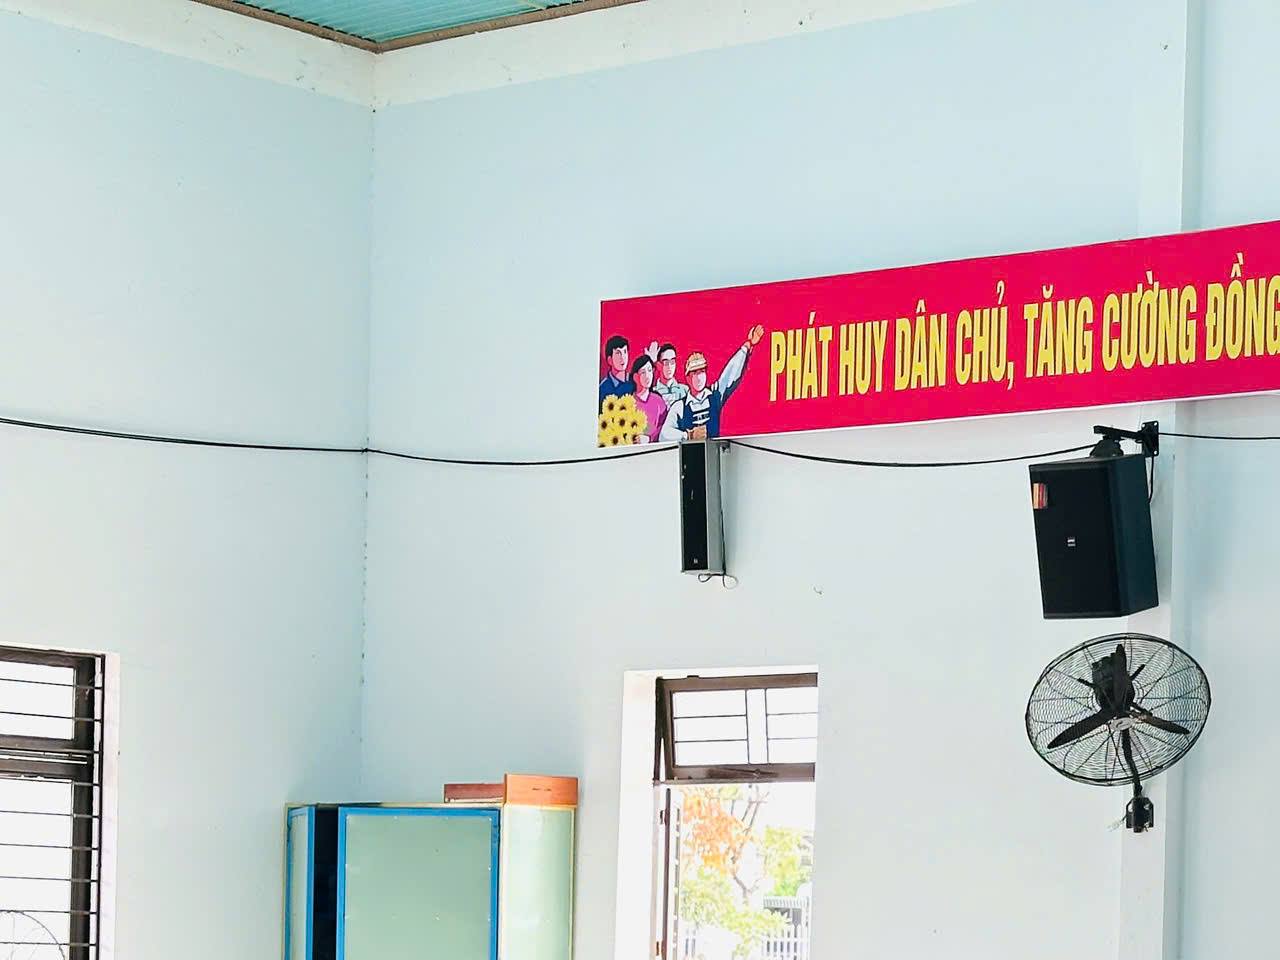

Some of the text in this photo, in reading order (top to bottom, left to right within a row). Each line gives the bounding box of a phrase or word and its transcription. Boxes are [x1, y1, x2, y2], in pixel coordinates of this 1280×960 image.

[769, 311, 833, 402] PHÁT
[838, 320, 889, 396] HUY
[894, 299, 948, 391] DÂN
[955, 281, 1014, 390] CHỦ,
[1023, 289, 1094, 378] TĂNG
[1101, 271, 1197, 371] CƯỜNG
